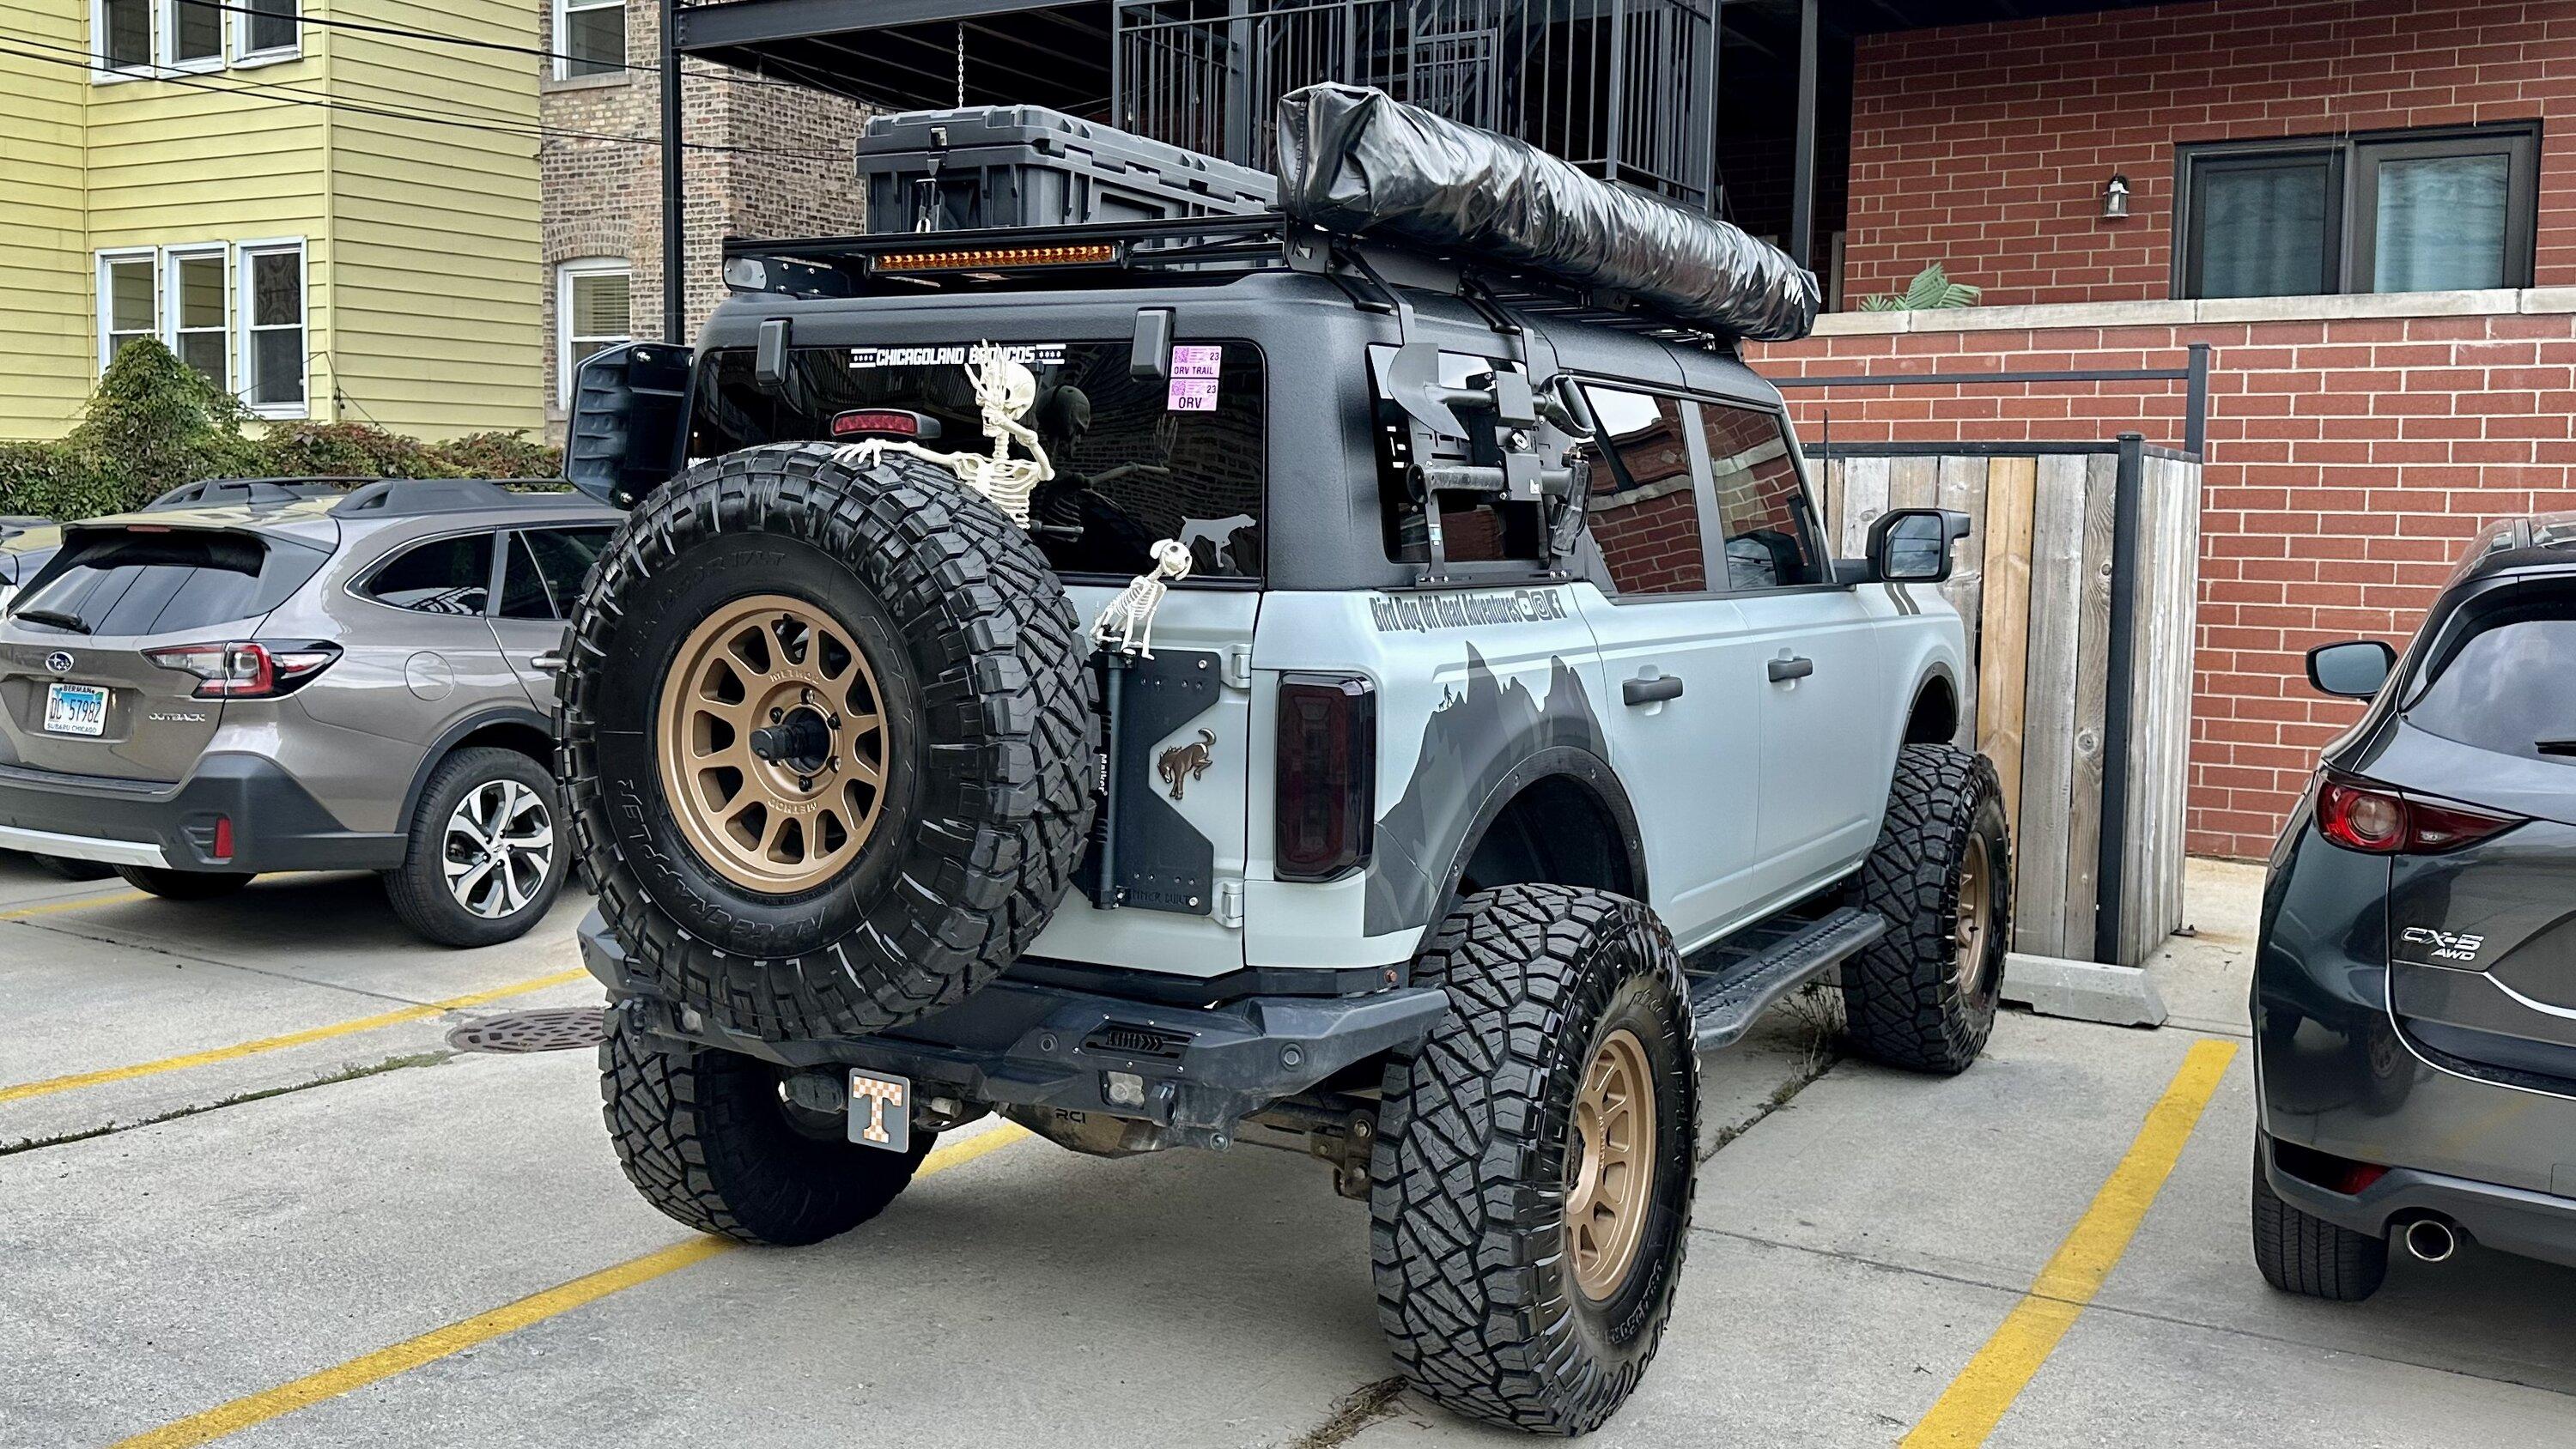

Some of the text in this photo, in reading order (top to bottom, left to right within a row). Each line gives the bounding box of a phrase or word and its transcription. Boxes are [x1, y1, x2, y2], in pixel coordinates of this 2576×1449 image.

[876, 347, 965, 366] CHICAGOLAND
[1209, 352, 1219, 361] 23
[1174, 366, 1213, 375] ORV TRAIL
[1206, 385, 1216, 394] 23
[1178, 397, 1202, 409] ORV
[1369, 593, 1523, 634] Bird Dog Off Road Adventures
[69, 699, 101, 723] 57982
[149, 712, 206, 722] OUTBACK
[47, 723, 70, 731] SUBARU
[2401, 926, 2484, 951] CX-5
[2431, 948, 2476, 961] AWD
[1055, 1107, 1086, 1124] RCI
